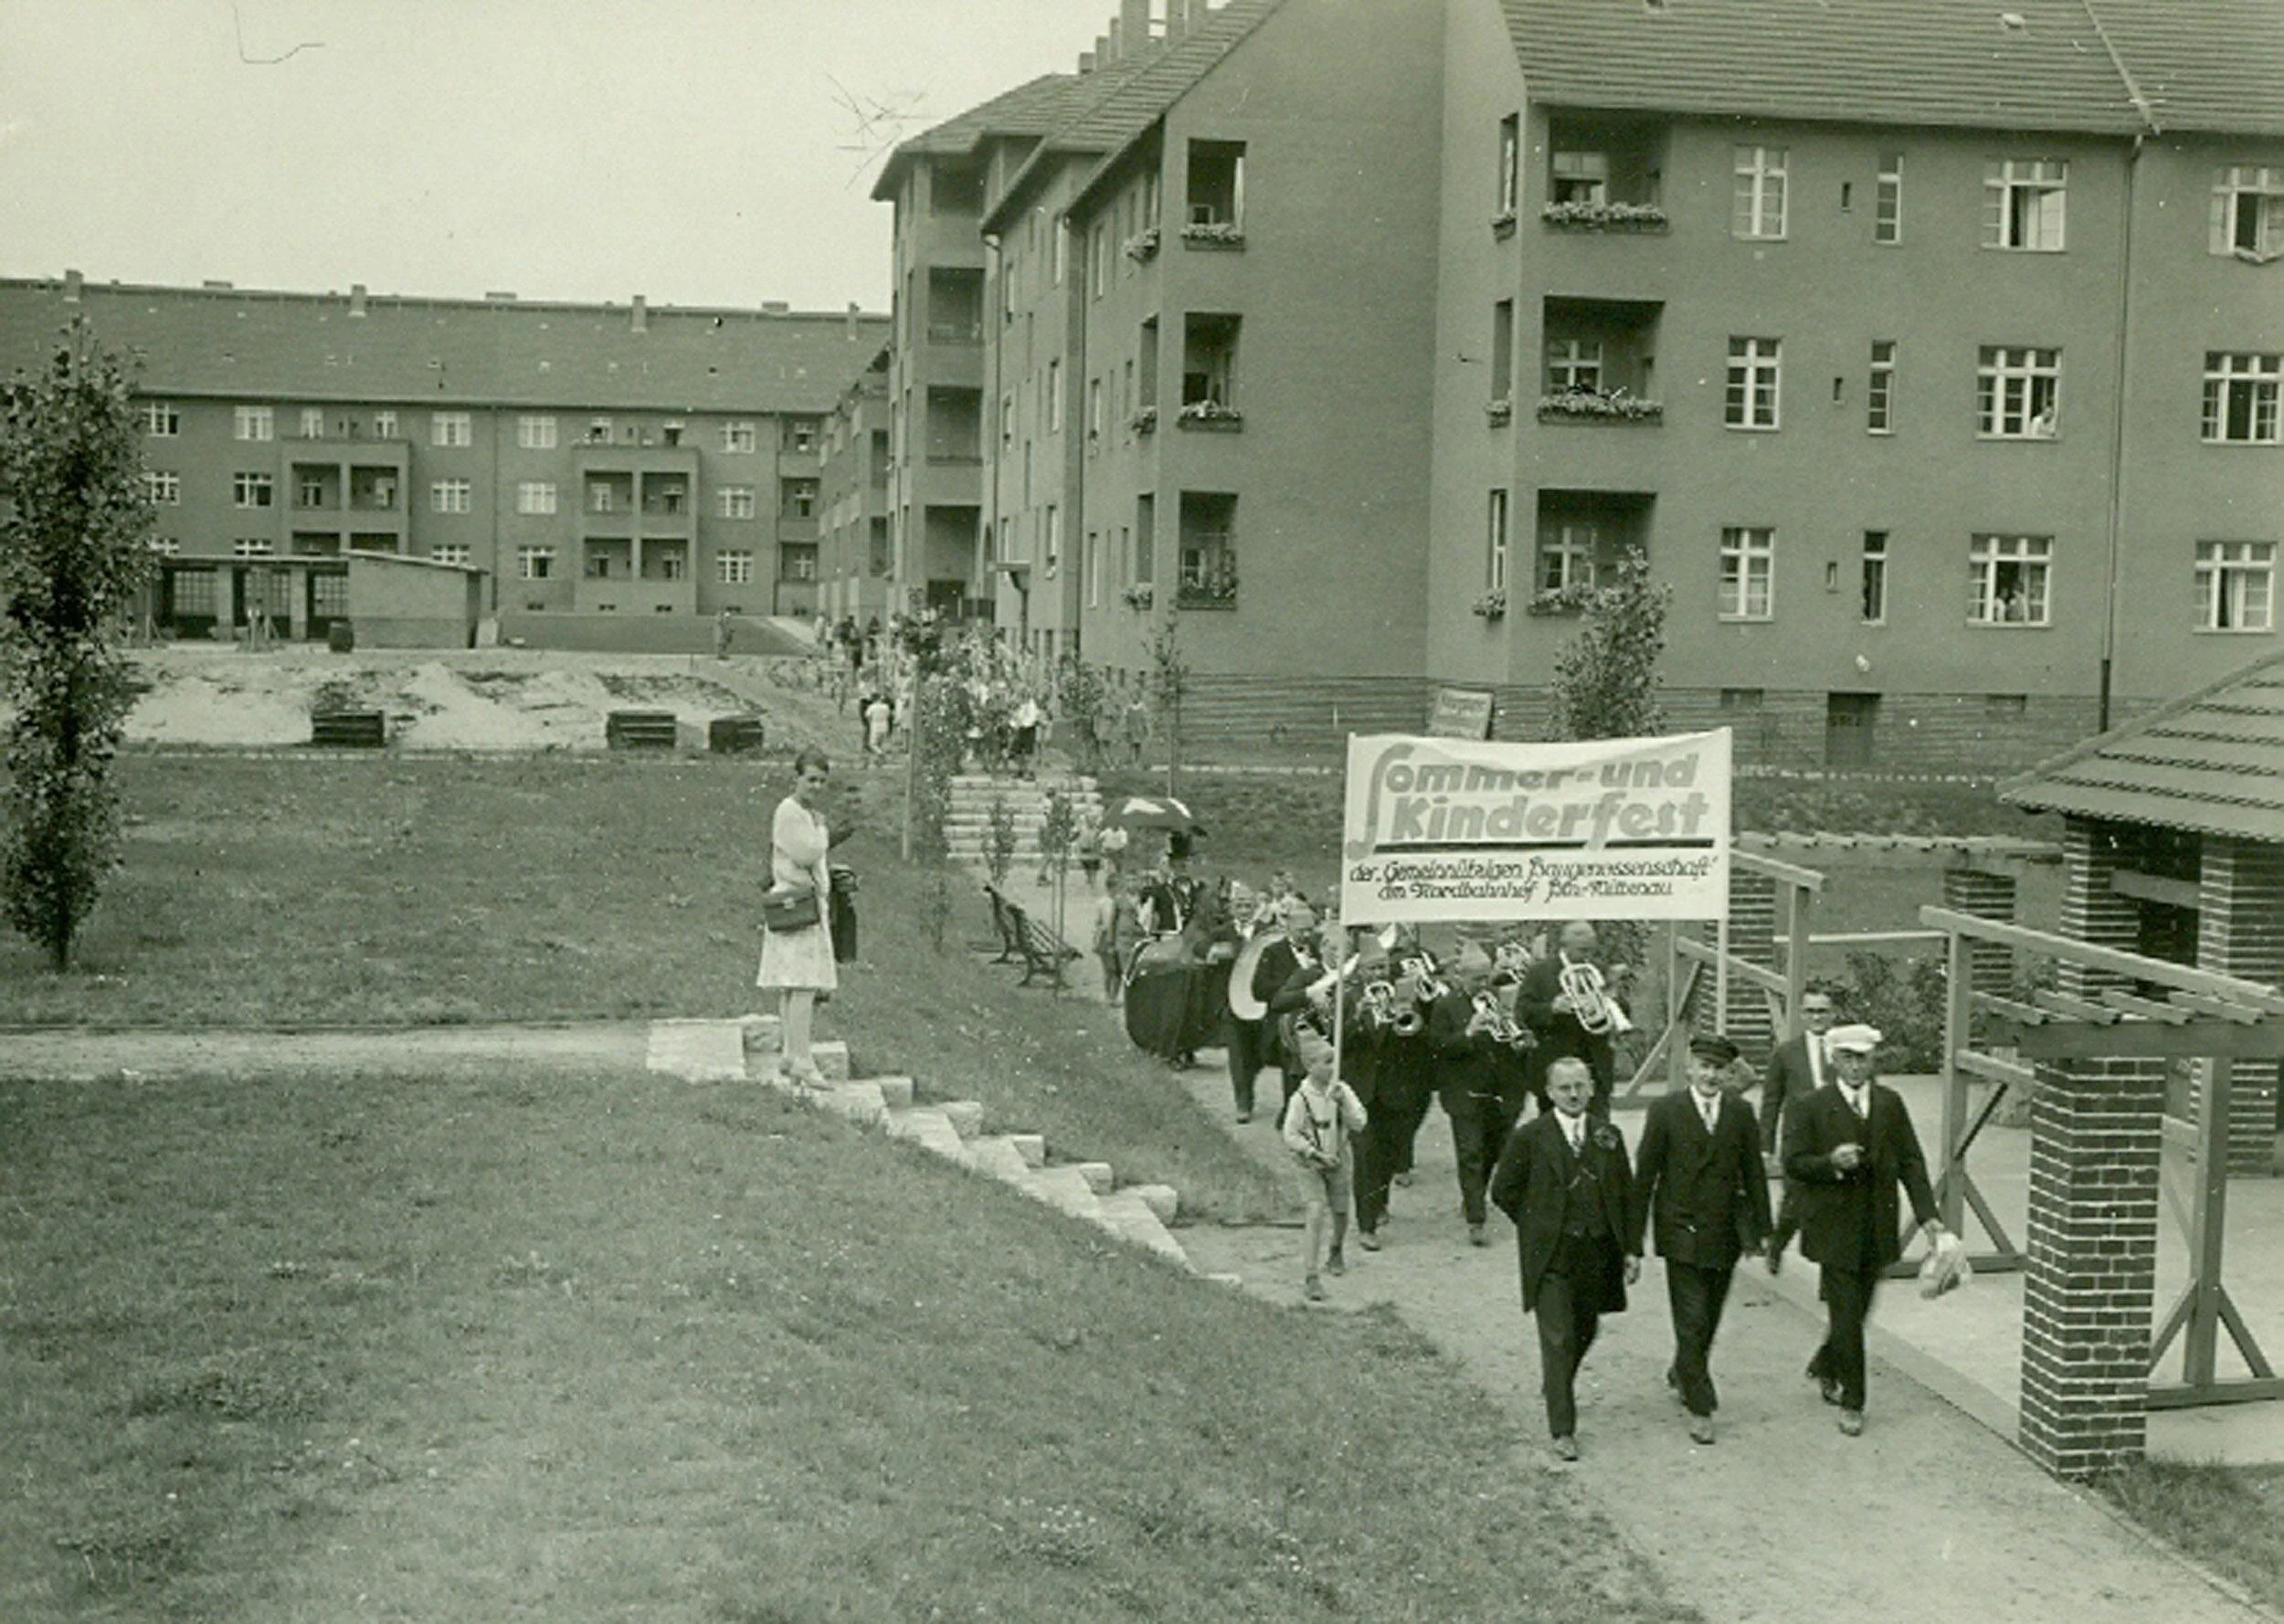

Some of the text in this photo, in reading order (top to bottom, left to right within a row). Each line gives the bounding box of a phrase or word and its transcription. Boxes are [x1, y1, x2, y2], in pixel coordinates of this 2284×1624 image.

[1599, 753, 1699, 788] und
[1390, 790, 1709, 851] Kinderfest
[1349, 863, 1378, 882] der
[1410, 880, 1538, 904] Nordbahnhof
